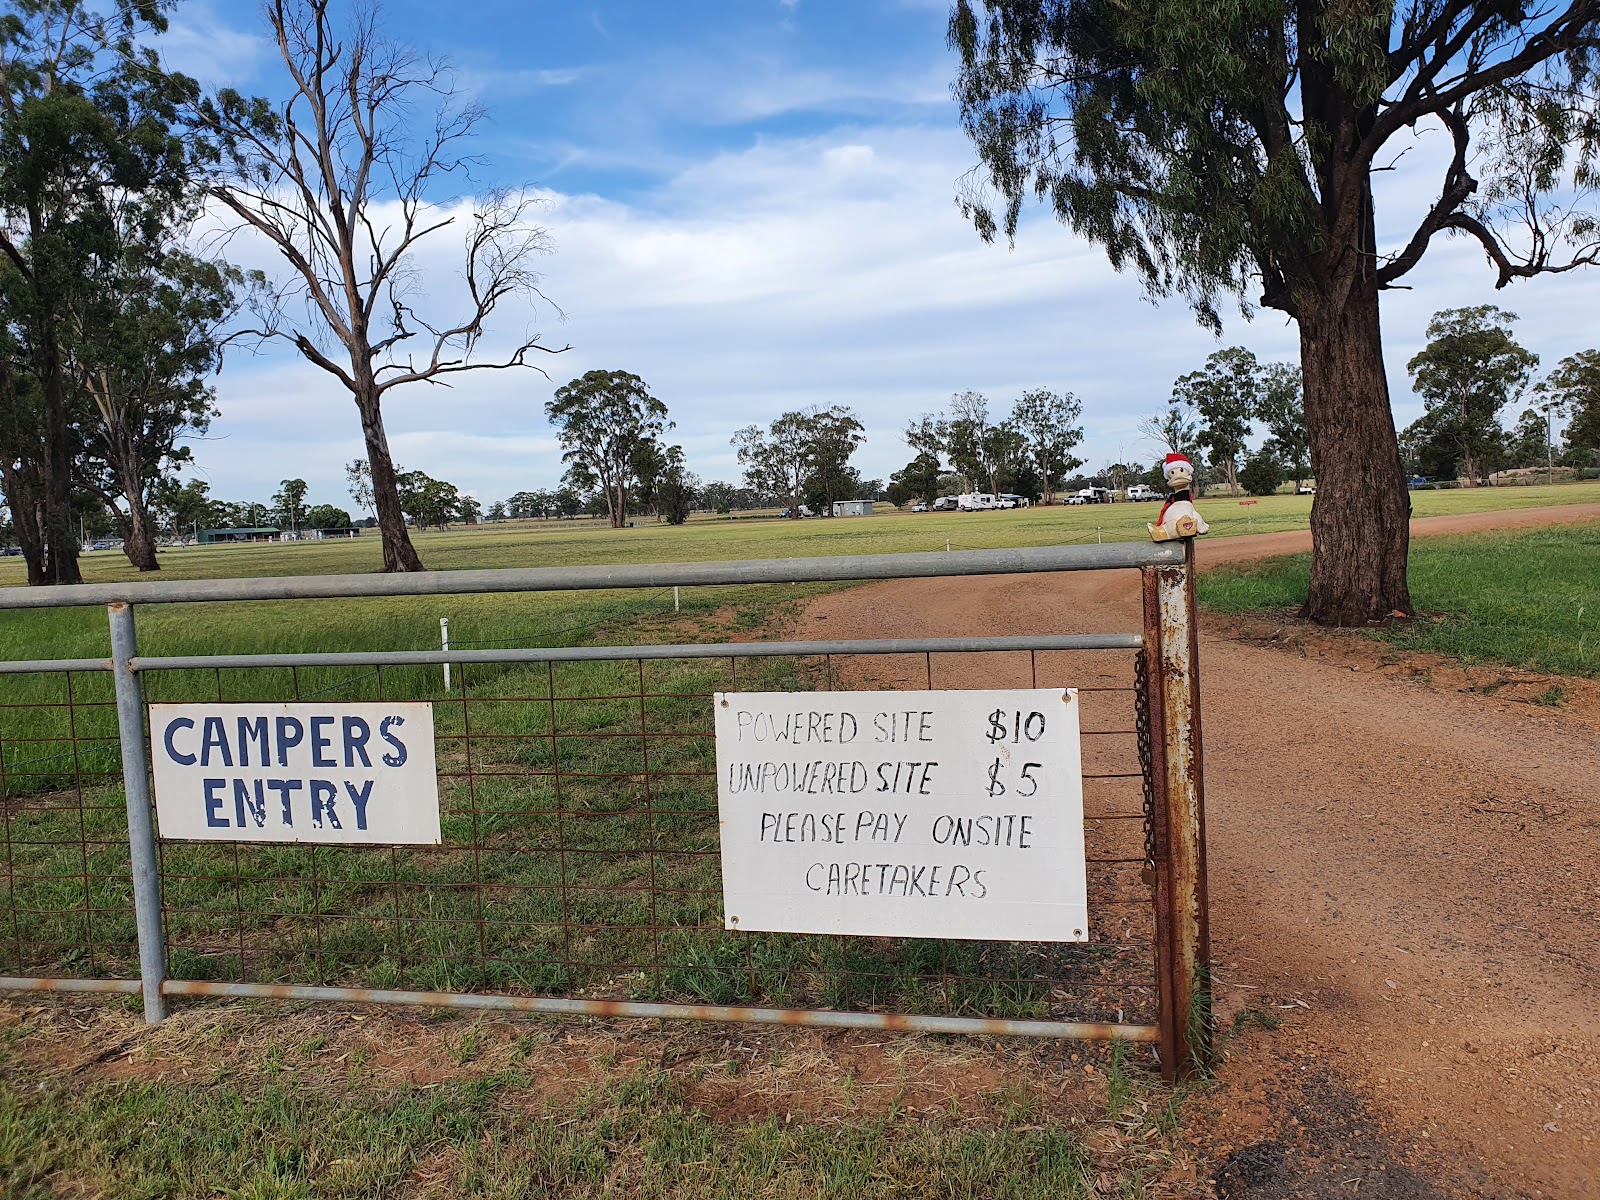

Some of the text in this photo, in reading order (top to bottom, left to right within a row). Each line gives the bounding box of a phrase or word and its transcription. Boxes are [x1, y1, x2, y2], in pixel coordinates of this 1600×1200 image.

[163, 715, 408, 768] CAMPERS
[737, 708, 1046, 745] POWERED SITE $10
[728, 760, 868, 795] UNPOWERED
[876, 761, 939, 795] SITE
[202, 778, 375, 831] ENTRY
[760, 810, 1033, 849] PLEASE PAY ONSITE
[805, 861, 988, 899] CARETAKERS
